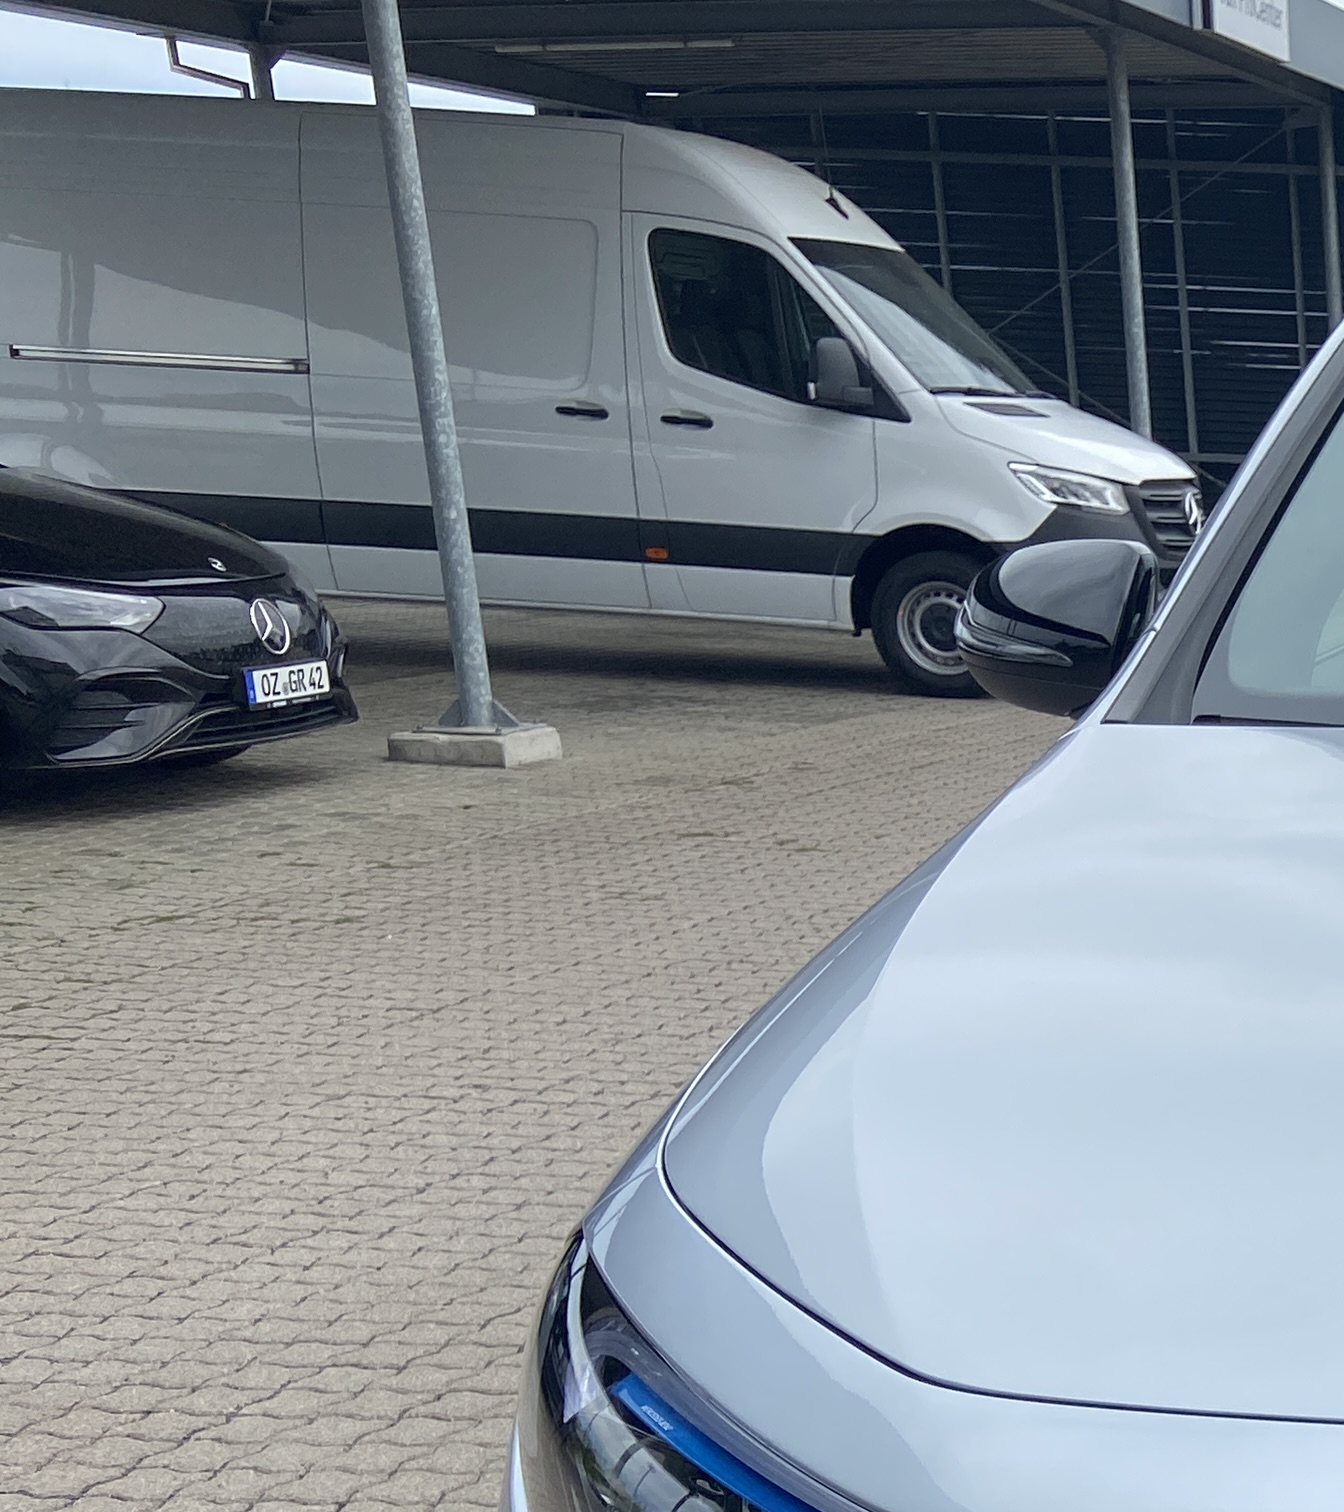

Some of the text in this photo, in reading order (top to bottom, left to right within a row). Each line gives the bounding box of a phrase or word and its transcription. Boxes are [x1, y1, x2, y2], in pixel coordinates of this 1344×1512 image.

[262, 667, 324, 696] OZ GR 42
